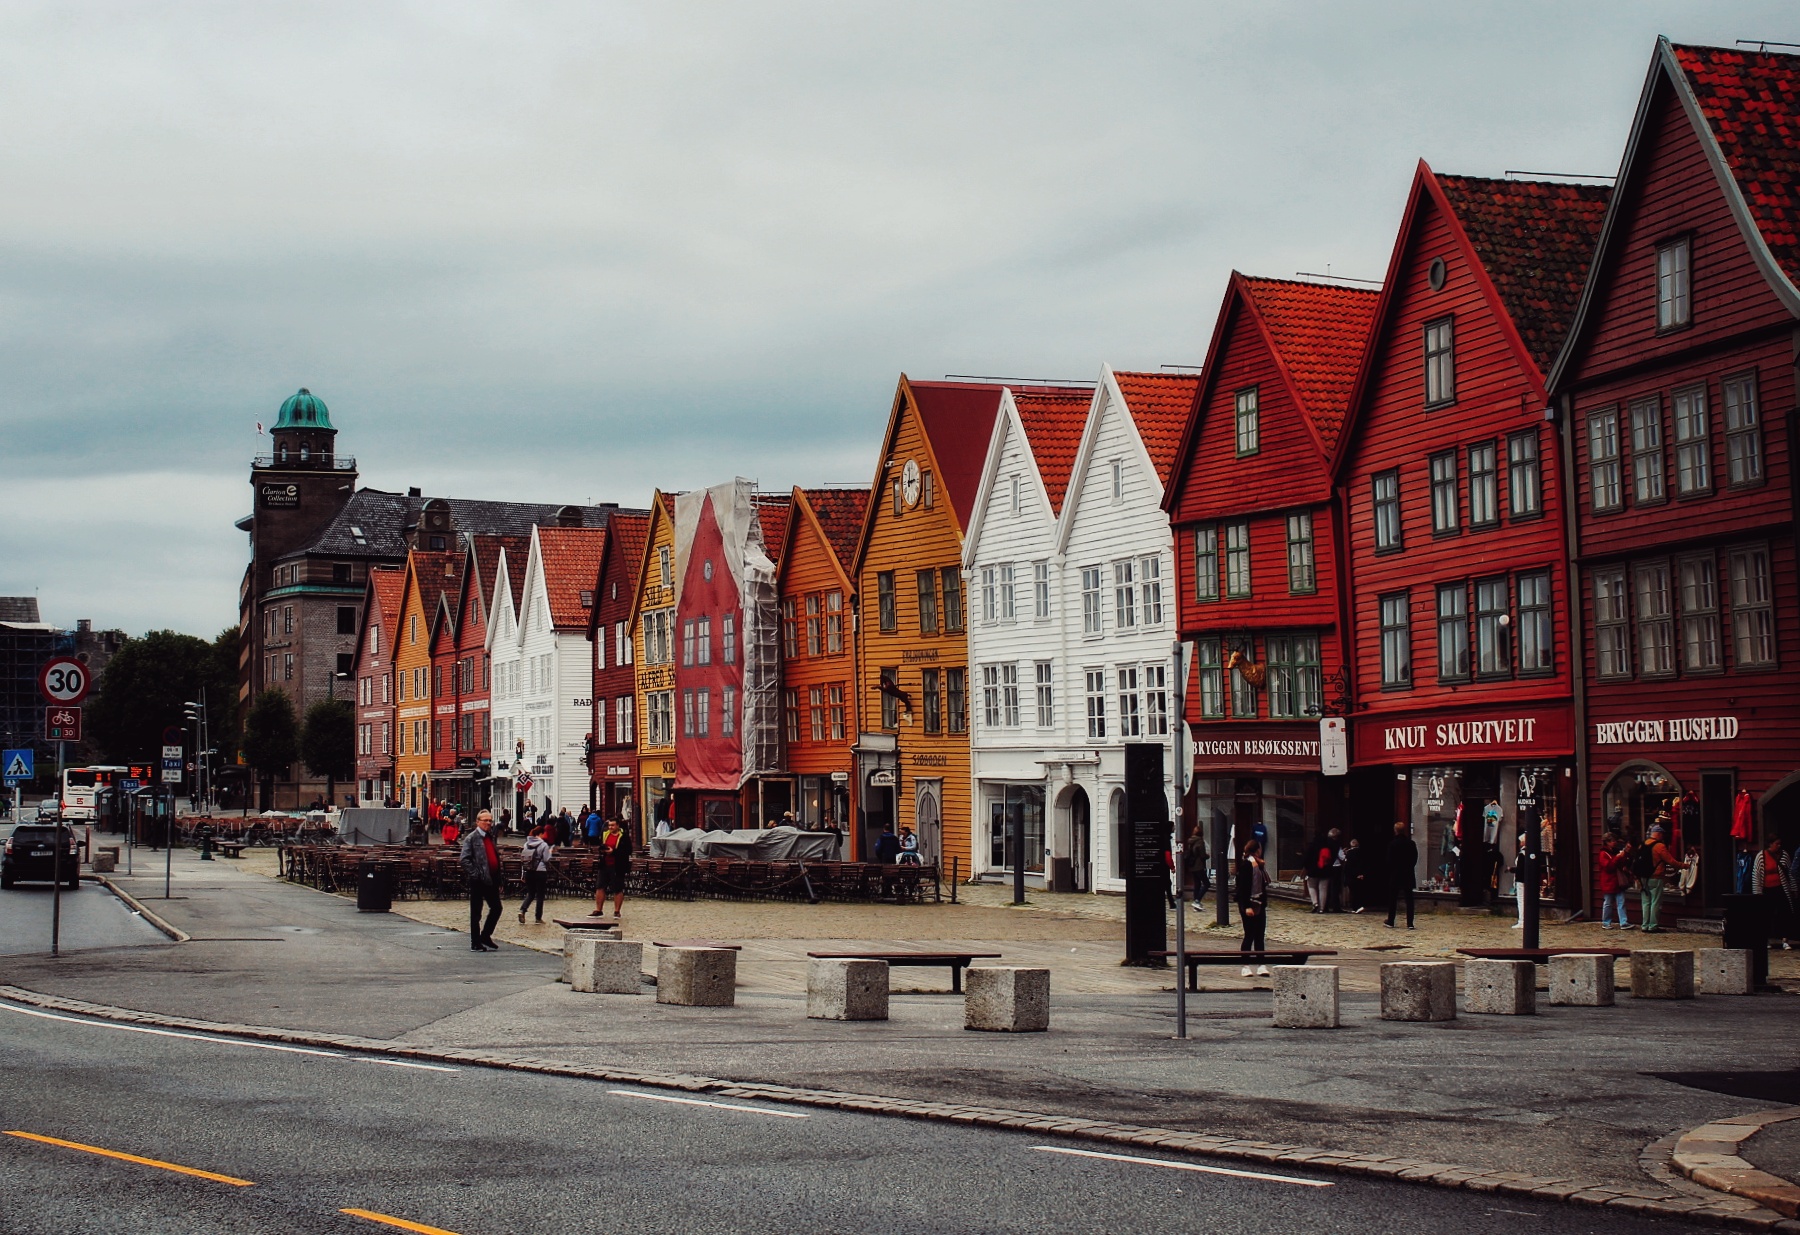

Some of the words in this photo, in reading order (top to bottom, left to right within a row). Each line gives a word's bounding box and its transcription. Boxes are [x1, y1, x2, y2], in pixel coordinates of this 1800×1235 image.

[262, 486, 286, 495] Clarion
[49, 669, 82, 693] 30
[1384, 725, 1428, 750] KNUT
[1435, 718, 1537, 747] SKURTVEIT
[1595, 719, 1665, 744] BRYGGEN
[1668, 716, 1739, 742] HUSFLID
[1192, 740, 1241, 756] BRYGGEN
[164, 760, 181, 768] Taxi
[122, 780, 138, 788] Taxi
